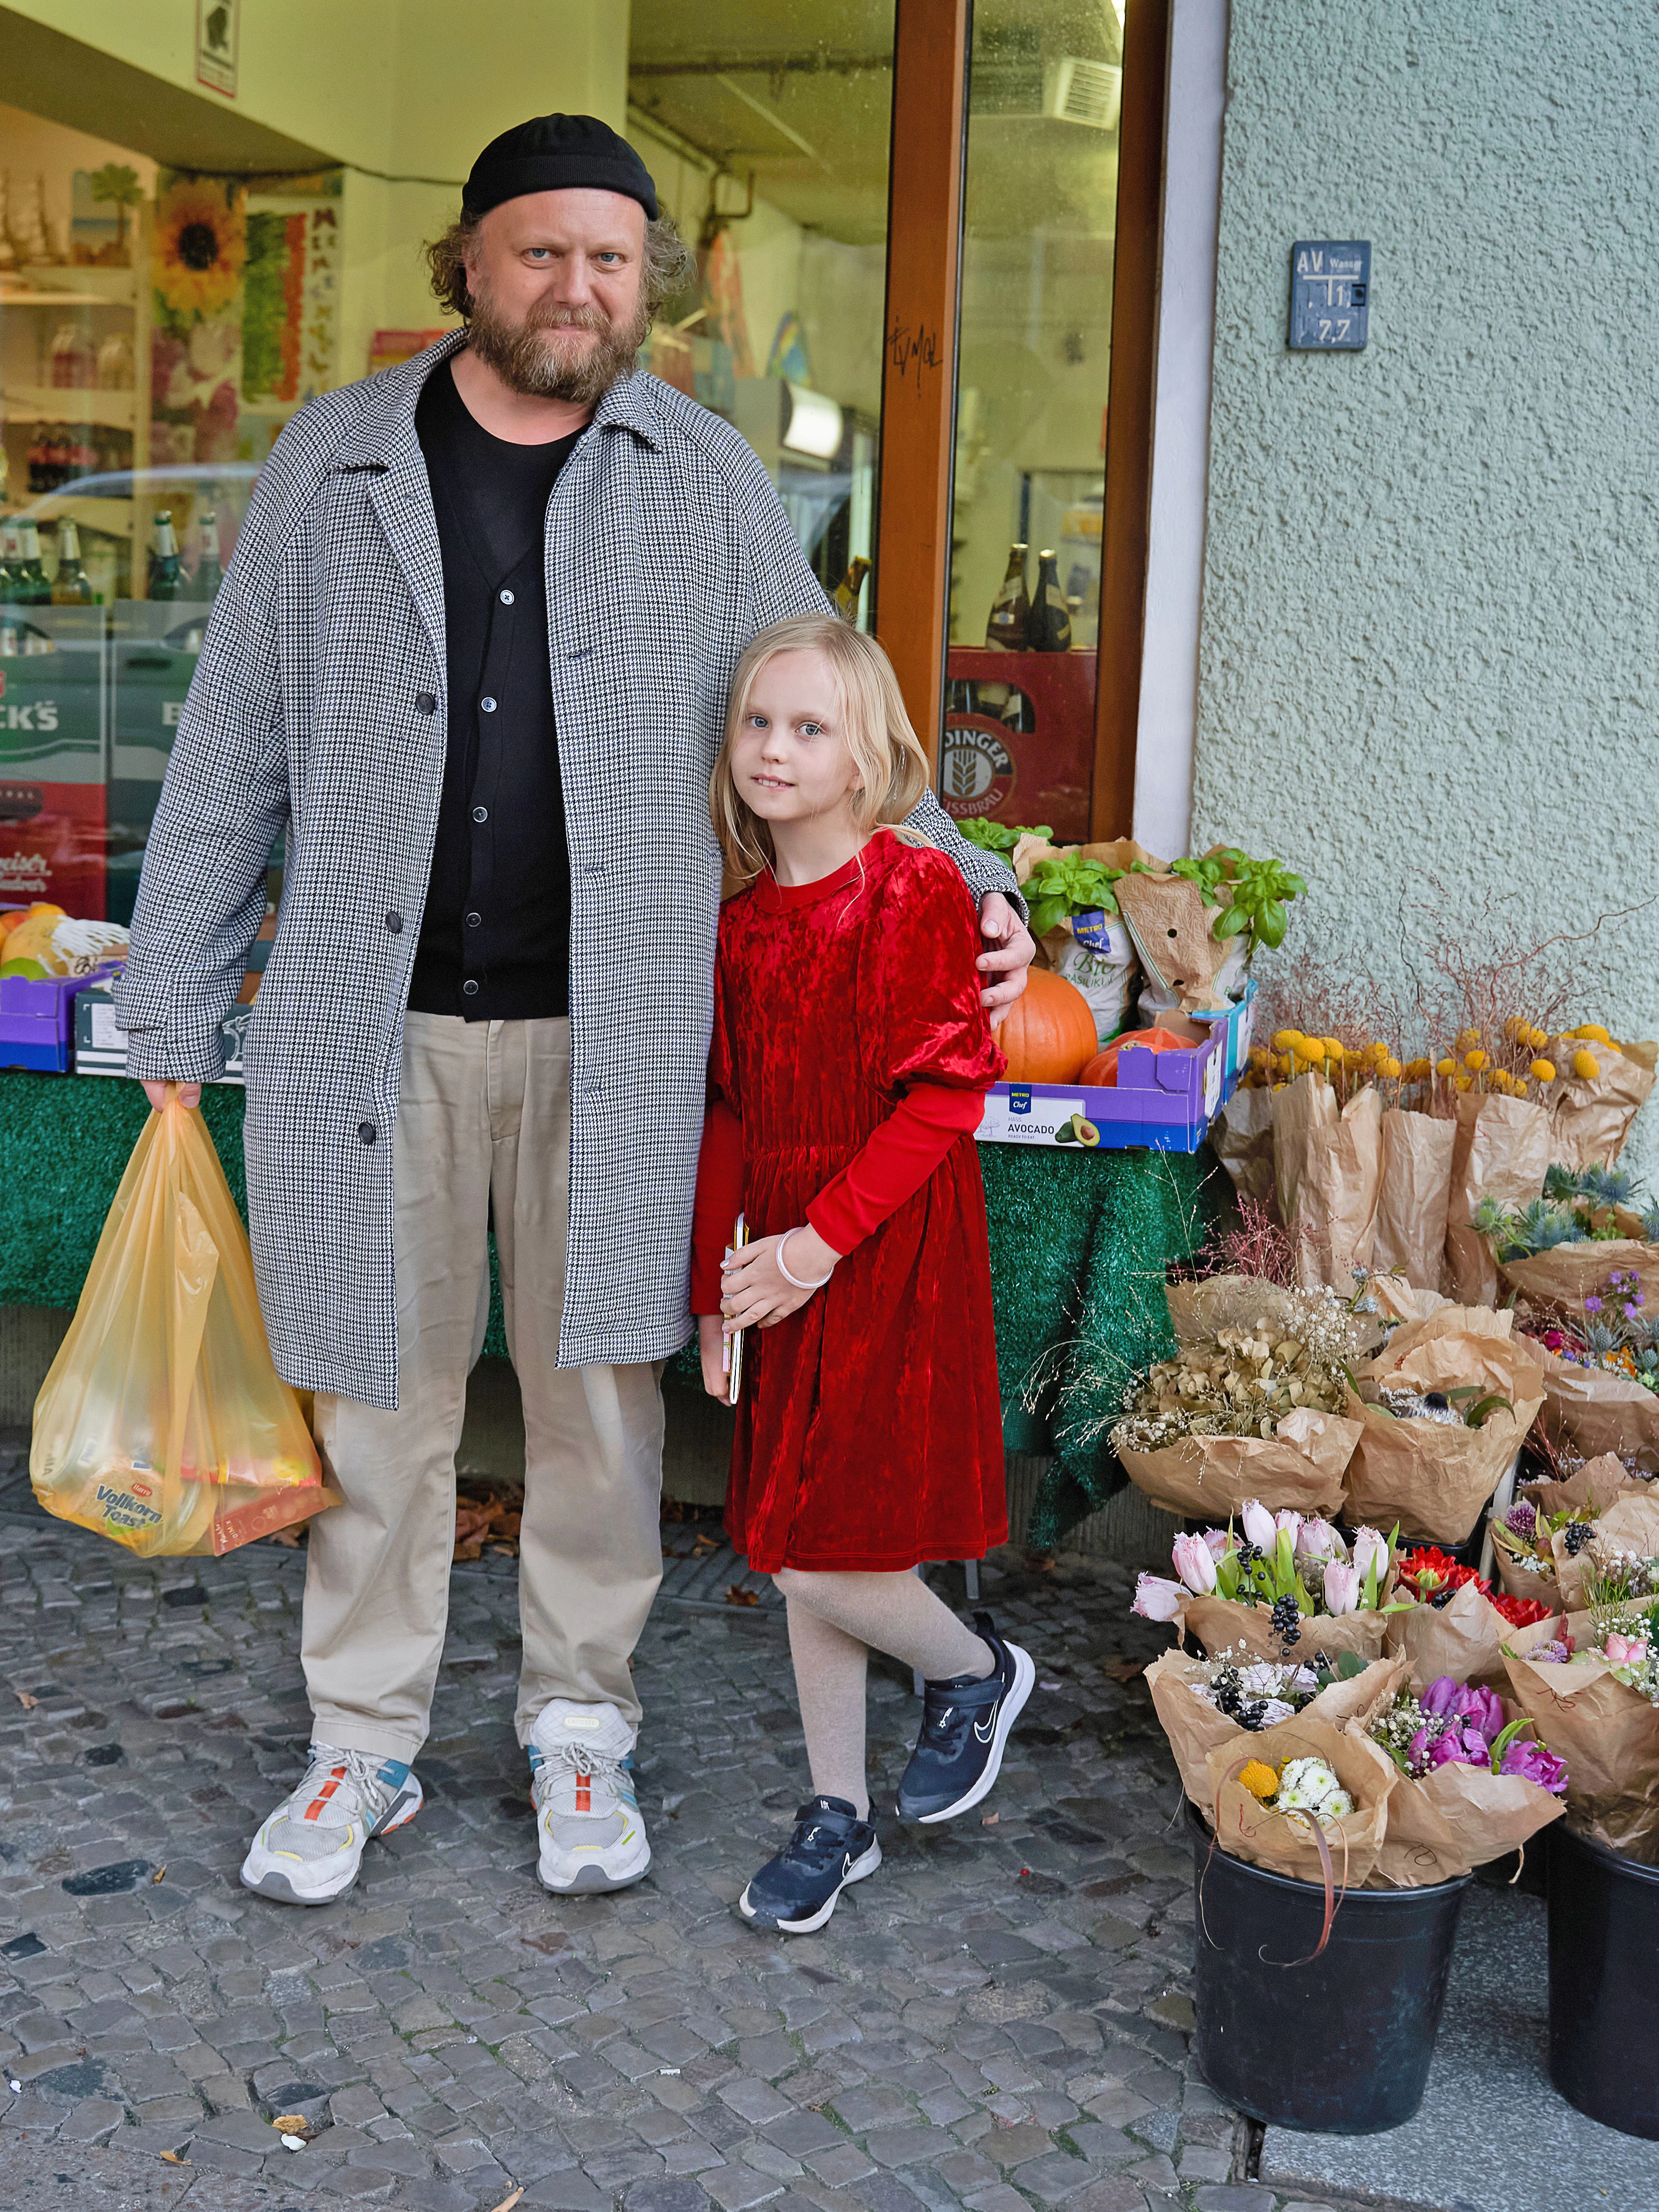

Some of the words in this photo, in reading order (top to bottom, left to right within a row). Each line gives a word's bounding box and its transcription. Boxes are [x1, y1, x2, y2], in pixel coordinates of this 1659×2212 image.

[1297, 248, 1324, 273] AV
[945, 729, 1009, 768] DINGER
[1077, 923, 1103, 934] METRO
[1083, 937, 1104, 949] Chef
[1073, 951, 1116, 976] Bio
[1013, 1100, 1028, 1110] Chef
[1007, 1124, 1054, 1134] AVOCADO
[133, 1484, 152, 1497] Harry
[96, 1485, 162, 1524] Vollkorn
[102, 1506, 146, 1529] Toast
